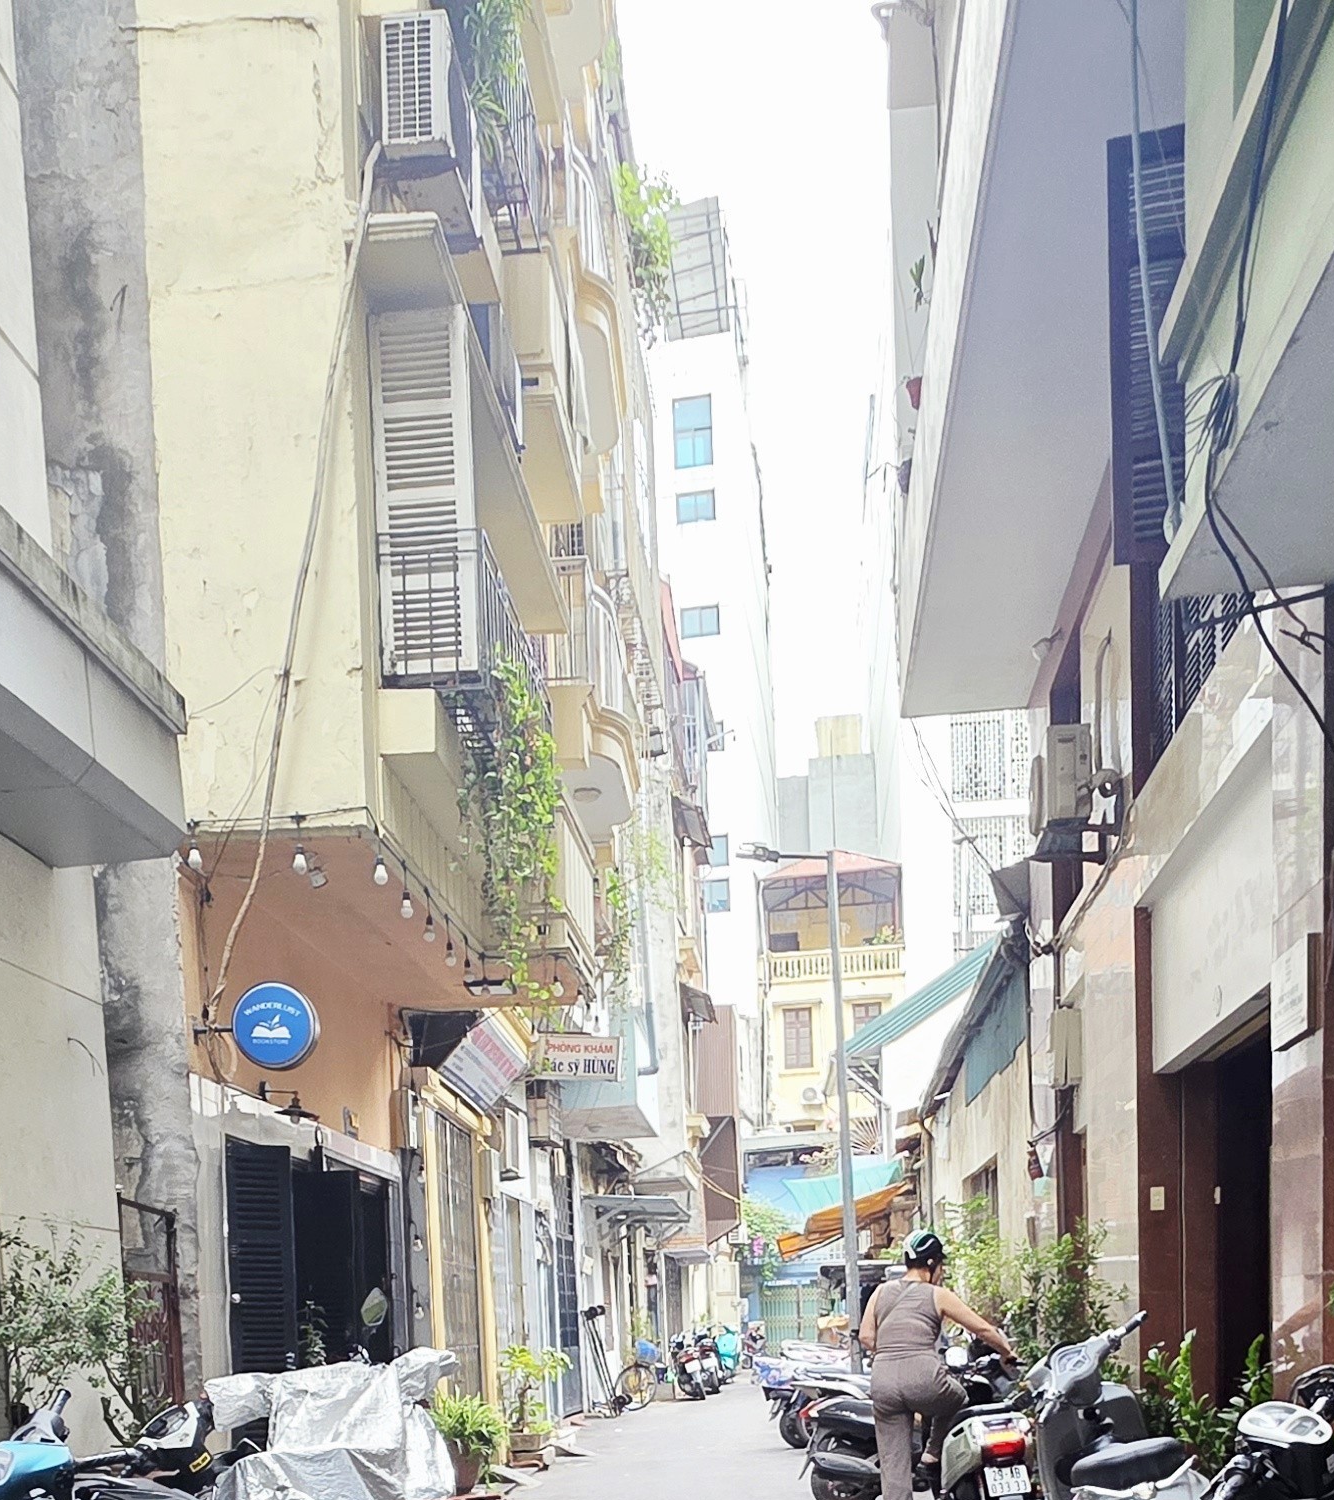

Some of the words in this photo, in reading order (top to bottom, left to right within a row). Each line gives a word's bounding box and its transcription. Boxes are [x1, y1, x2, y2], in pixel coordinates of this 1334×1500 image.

[243, 1001, 301, 1017] WANDERLUST
[547, 1041, 581, 1054] PHÒNG
[584, 1042, 613, 1054] KHÁM
[567, 1059, 580, 1076] sỹ
[583, 1056, 616, 1075] HÙNG
